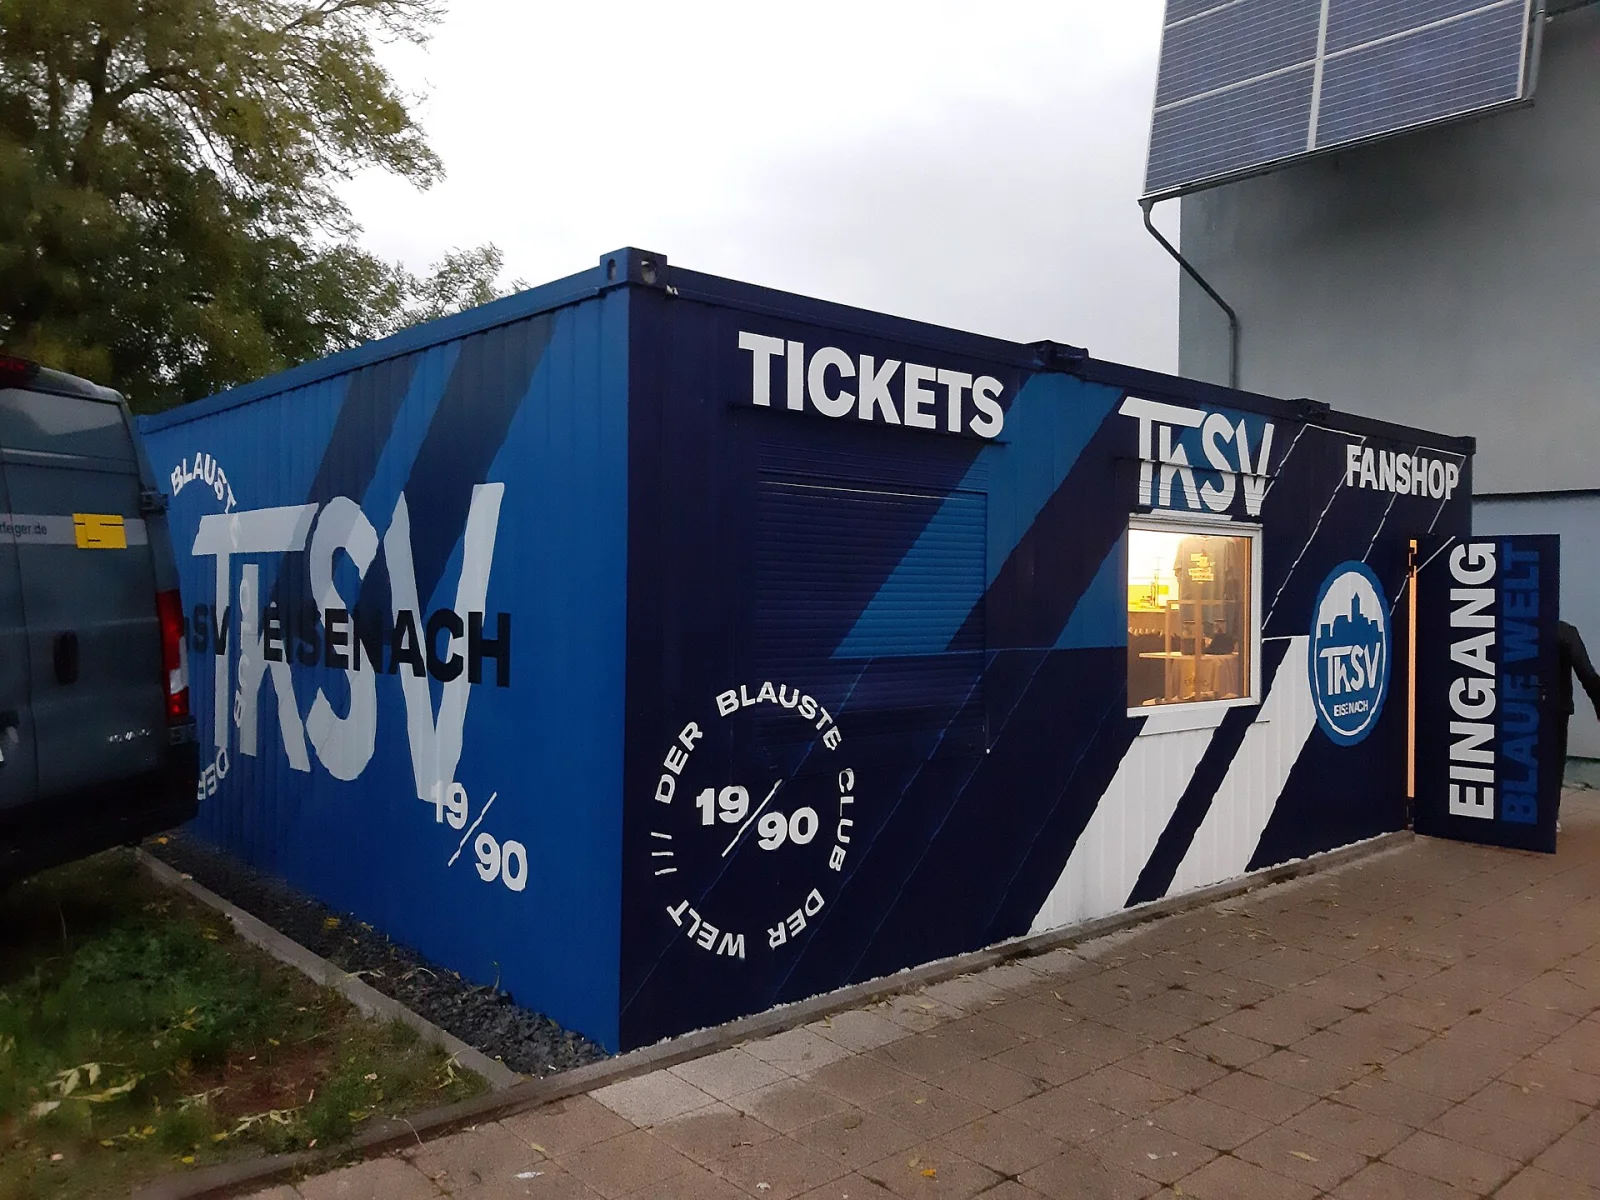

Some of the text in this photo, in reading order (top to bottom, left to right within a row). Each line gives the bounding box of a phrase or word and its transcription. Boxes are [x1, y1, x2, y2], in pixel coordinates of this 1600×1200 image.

[738, 331, 1006, 438] TICKETS
[1346, 444, 1460, 500] FANSHOP
[262, 606, 511, 689] EISENACH
[1449, 542, 1498, 820] EINGANG
[1501, 542, 1540, 825] BLAUE WELT
[1333, 700, 1369, 717] EISENACH
[655, 681, 855, 960] DER BLAUSTE CLUB DER WELT
